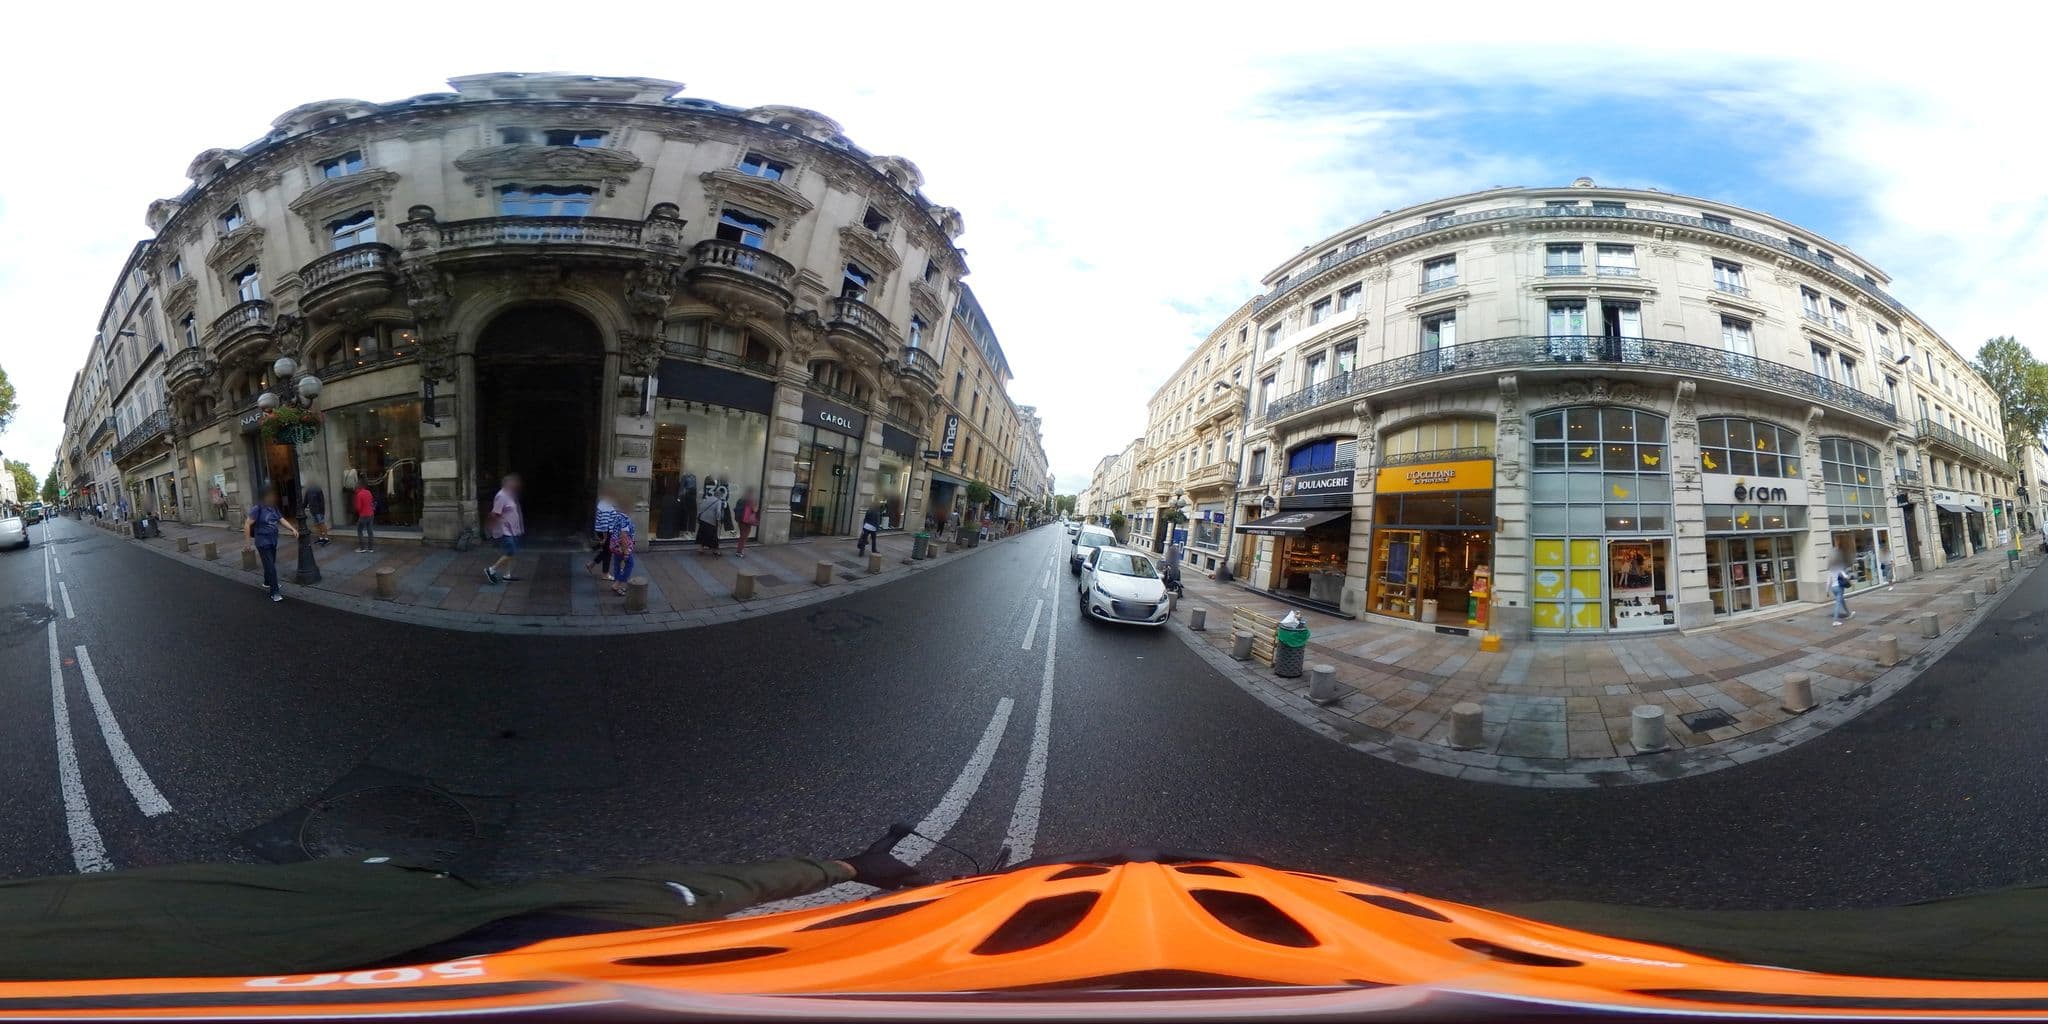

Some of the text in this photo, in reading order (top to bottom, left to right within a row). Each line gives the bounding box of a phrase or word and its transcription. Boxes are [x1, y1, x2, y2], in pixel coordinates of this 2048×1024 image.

[820, 411, 852, 429] CAROLL
[942, 417, 958, 453] fnac
[1297, 477, 1350, 490] BOULANGERIE
